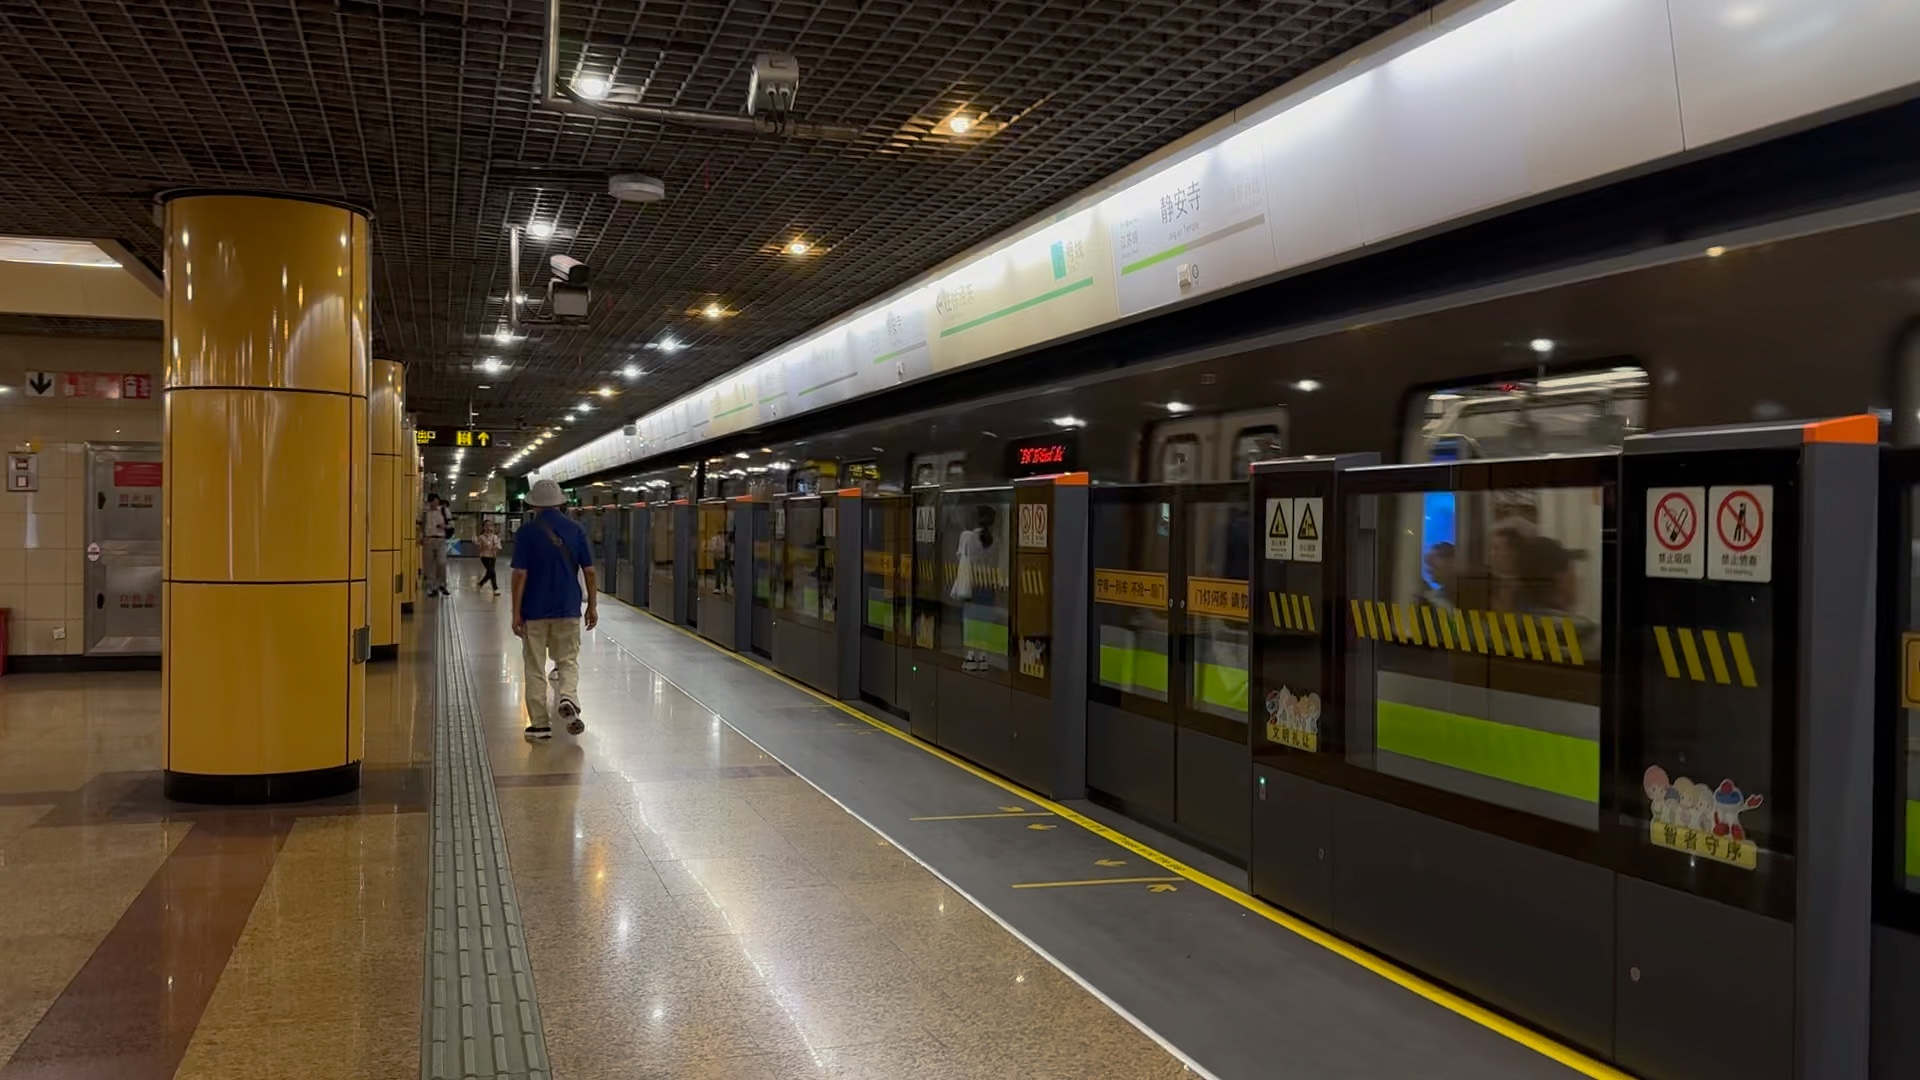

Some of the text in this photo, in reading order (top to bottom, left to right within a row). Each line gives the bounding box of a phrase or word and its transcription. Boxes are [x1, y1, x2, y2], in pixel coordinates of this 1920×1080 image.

[1160, 180, 1201, 224] 静安寺
[1272, 726, 1310, 749] 文明礼让
[1664, 823, 1741, 861] 智者守序
